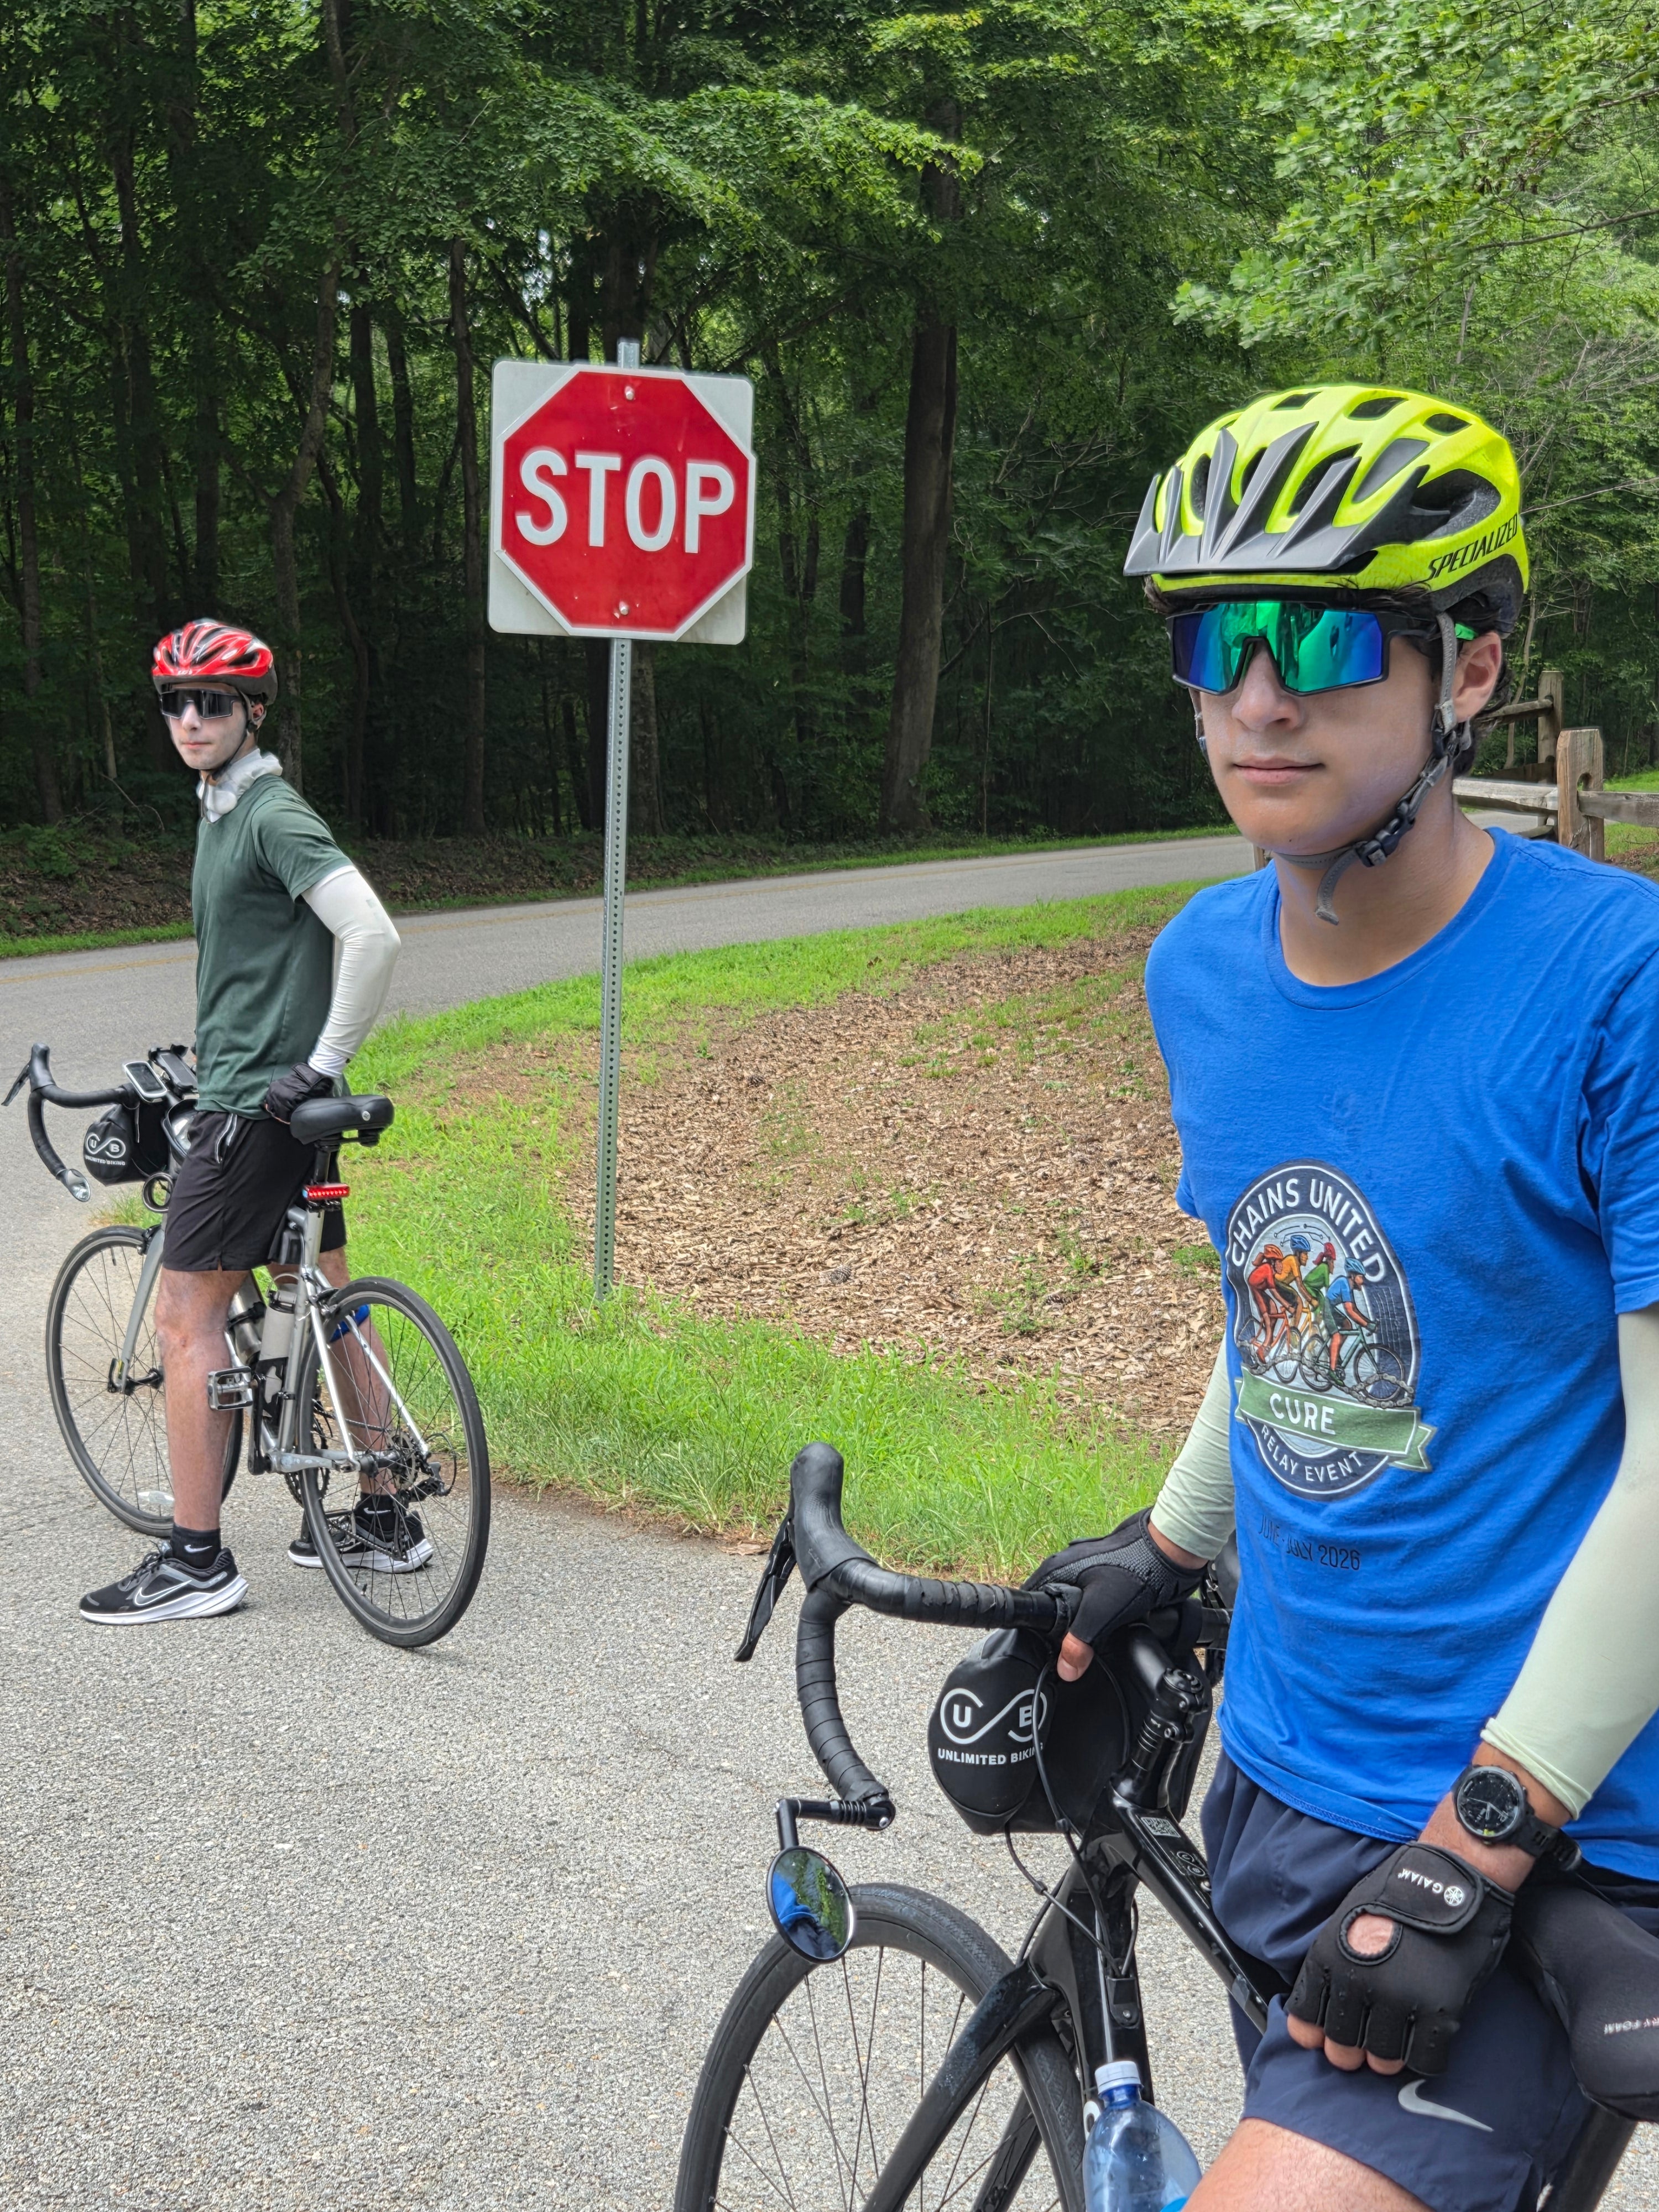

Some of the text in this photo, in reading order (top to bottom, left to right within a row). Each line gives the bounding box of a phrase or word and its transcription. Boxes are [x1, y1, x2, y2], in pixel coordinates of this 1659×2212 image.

[515, 450, 734, 554] STOP
[1425, 512, 1518, 581] SPECIALIZED
[111, 1144, 119, 1152] B
[1232, 1178, 1385, 1282] CHAINS UNITED
[1269, 1392, 1337, 1436] CURE
[1261, 1424, 1364, 1483] RELAY EVENT
[1318, 1544, 1361, 1571] 2026
[953, 1704, 972, 1728] U
[938, 1748, 1006, 1765] UNLIMITED
